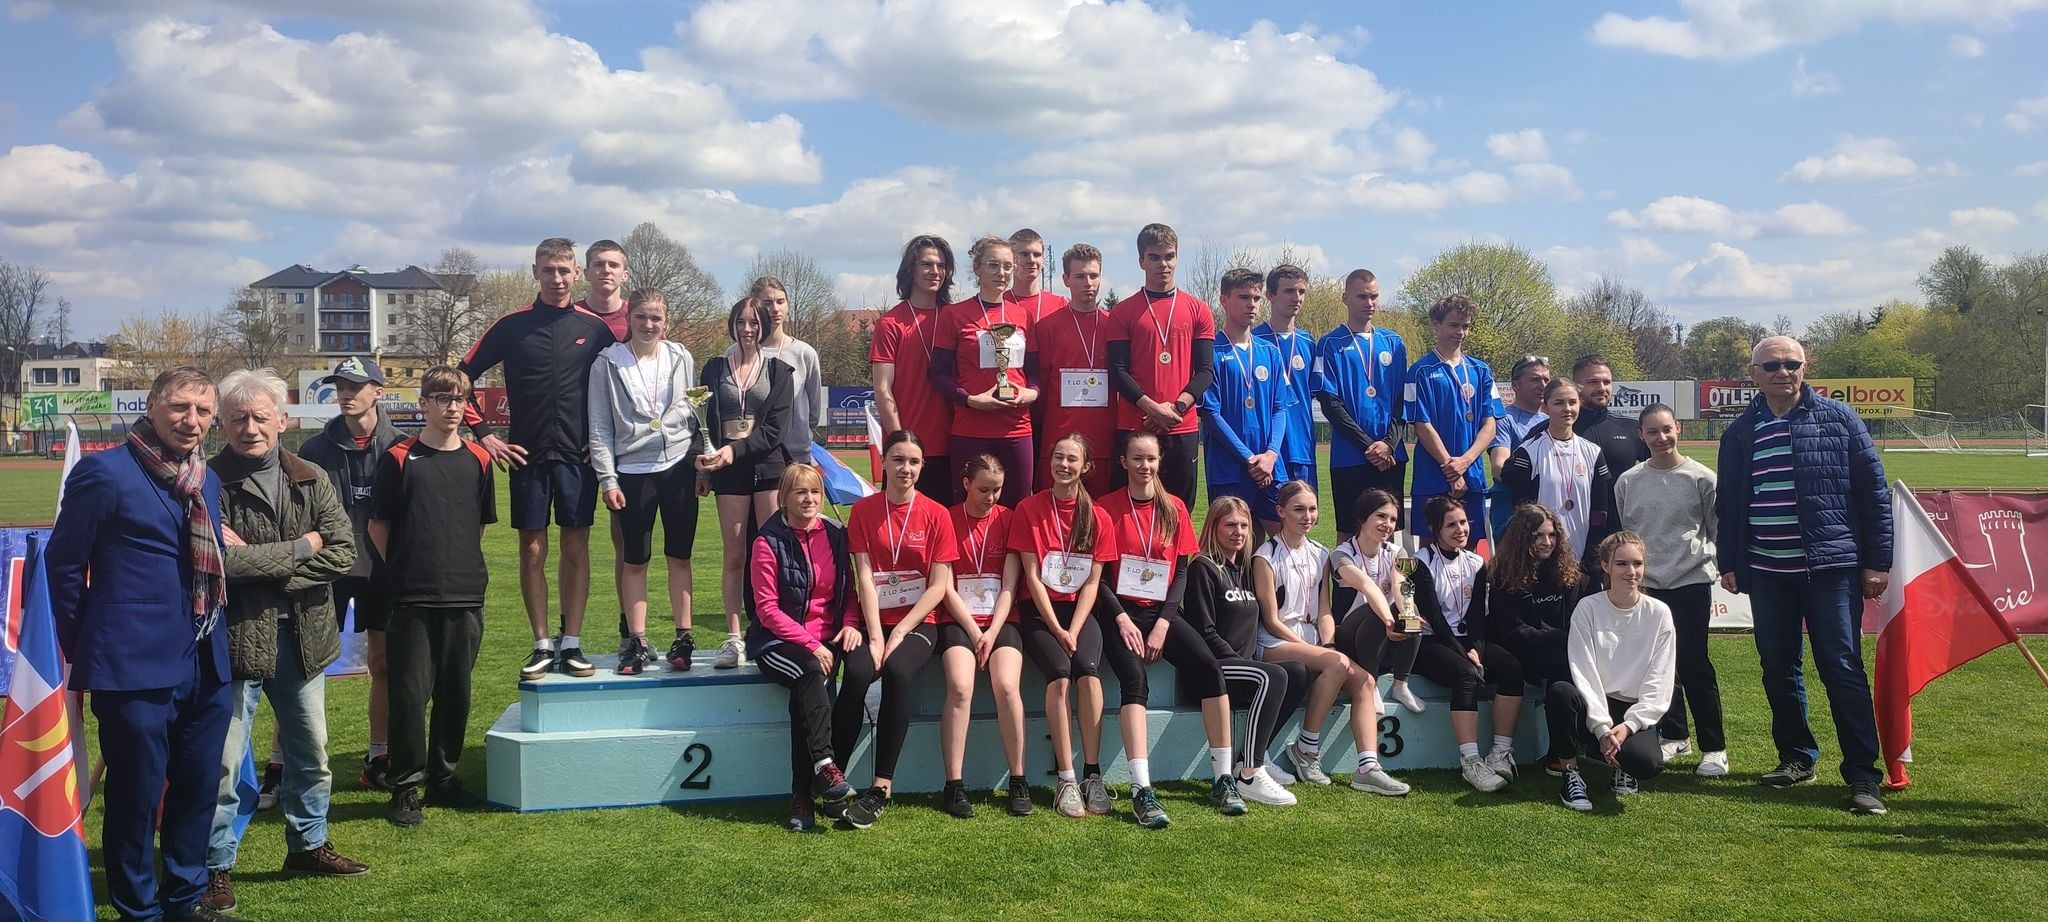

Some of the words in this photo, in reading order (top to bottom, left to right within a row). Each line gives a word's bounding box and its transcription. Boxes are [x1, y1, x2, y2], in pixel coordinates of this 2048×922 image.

[1608, 393, 1661, 407] K-BUD
[1830, 386, 1905, 403] elbrox
[117, 397, 148, 412] hab
[864, 399, 877, 407] St
[1377, 715, 1405, 758] 3
[680, 742, 713, 790] 2
